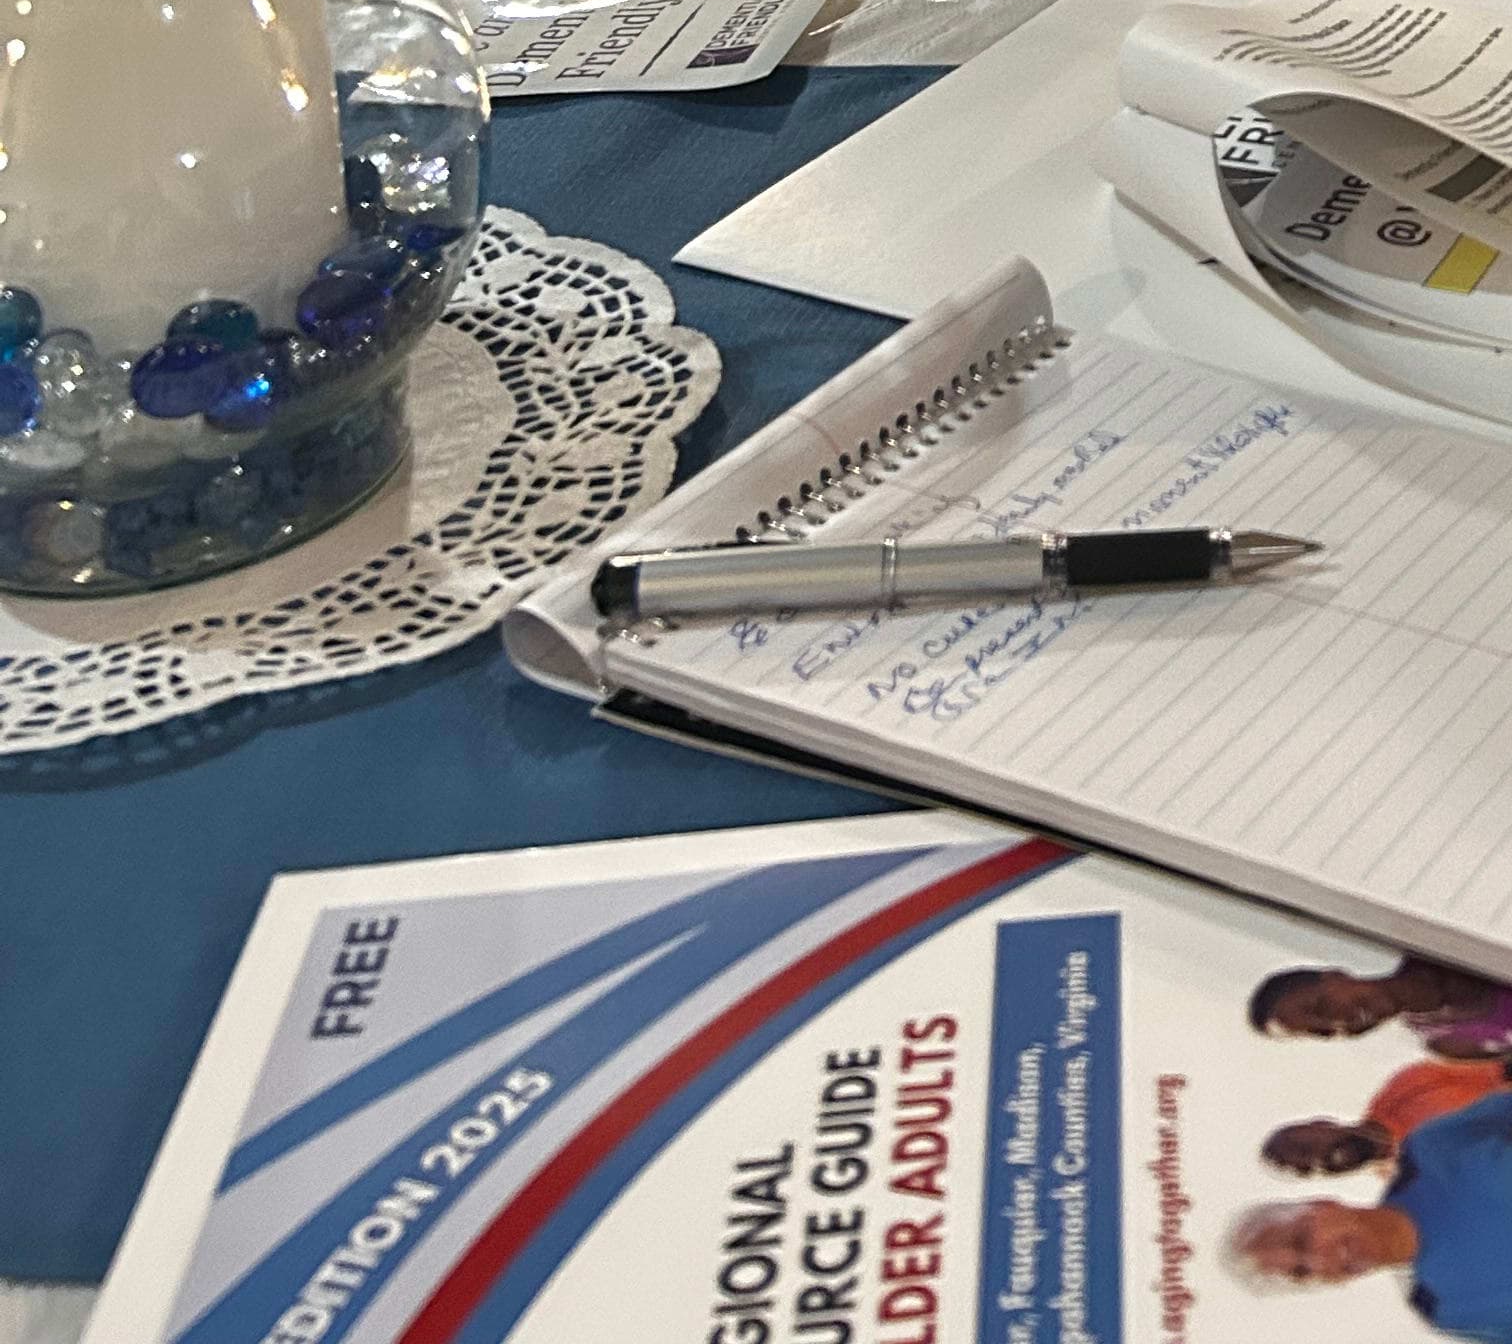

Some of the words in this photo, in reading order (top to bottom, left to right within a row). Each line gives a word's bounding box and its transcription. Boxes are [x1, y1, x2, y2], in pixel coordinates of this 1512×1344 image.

[311, 915, 400, 1039] FREE
[1056, 950, 1098, 1050] Virginia
[421, 1067, 555, 1178] 2025
[810, 1043, 883, 1197] GUIDE
[887, 1013, 960, 1200] ADULTS
[1004, 1041, 1048, 1165] Madison,
[1052, 1050, 1093, 1176] Counties,
[998, 1167, 1048, 1311] Fauquier,
